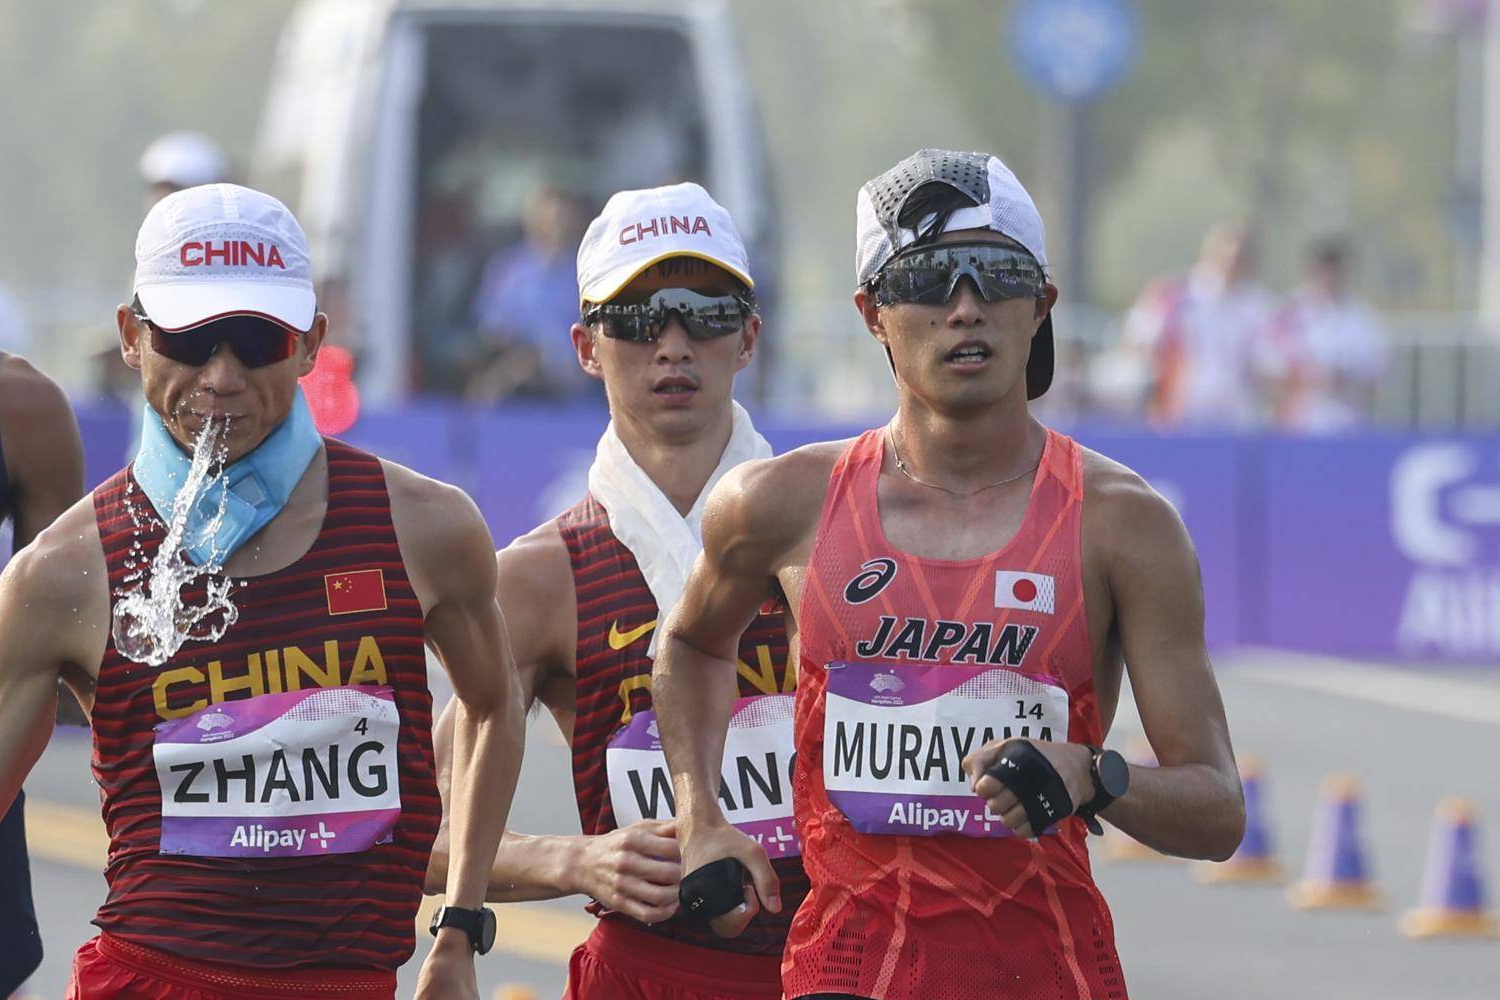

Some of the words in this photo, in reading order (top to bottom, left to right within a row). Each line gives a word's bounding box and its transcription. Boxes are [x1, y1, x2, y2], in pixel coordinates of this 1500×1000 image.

[619, 215, 712, 246] CHINA
[180, 240, 286, 270] CHINA
[856, 616, 1039, 666] JAPAN
[152, 635, 388, 721] CHINA
[1015, 700, 1044, 720] 14
[354, 717, 368, 735] 4
[170, 741, 389, 804] ZHANG
